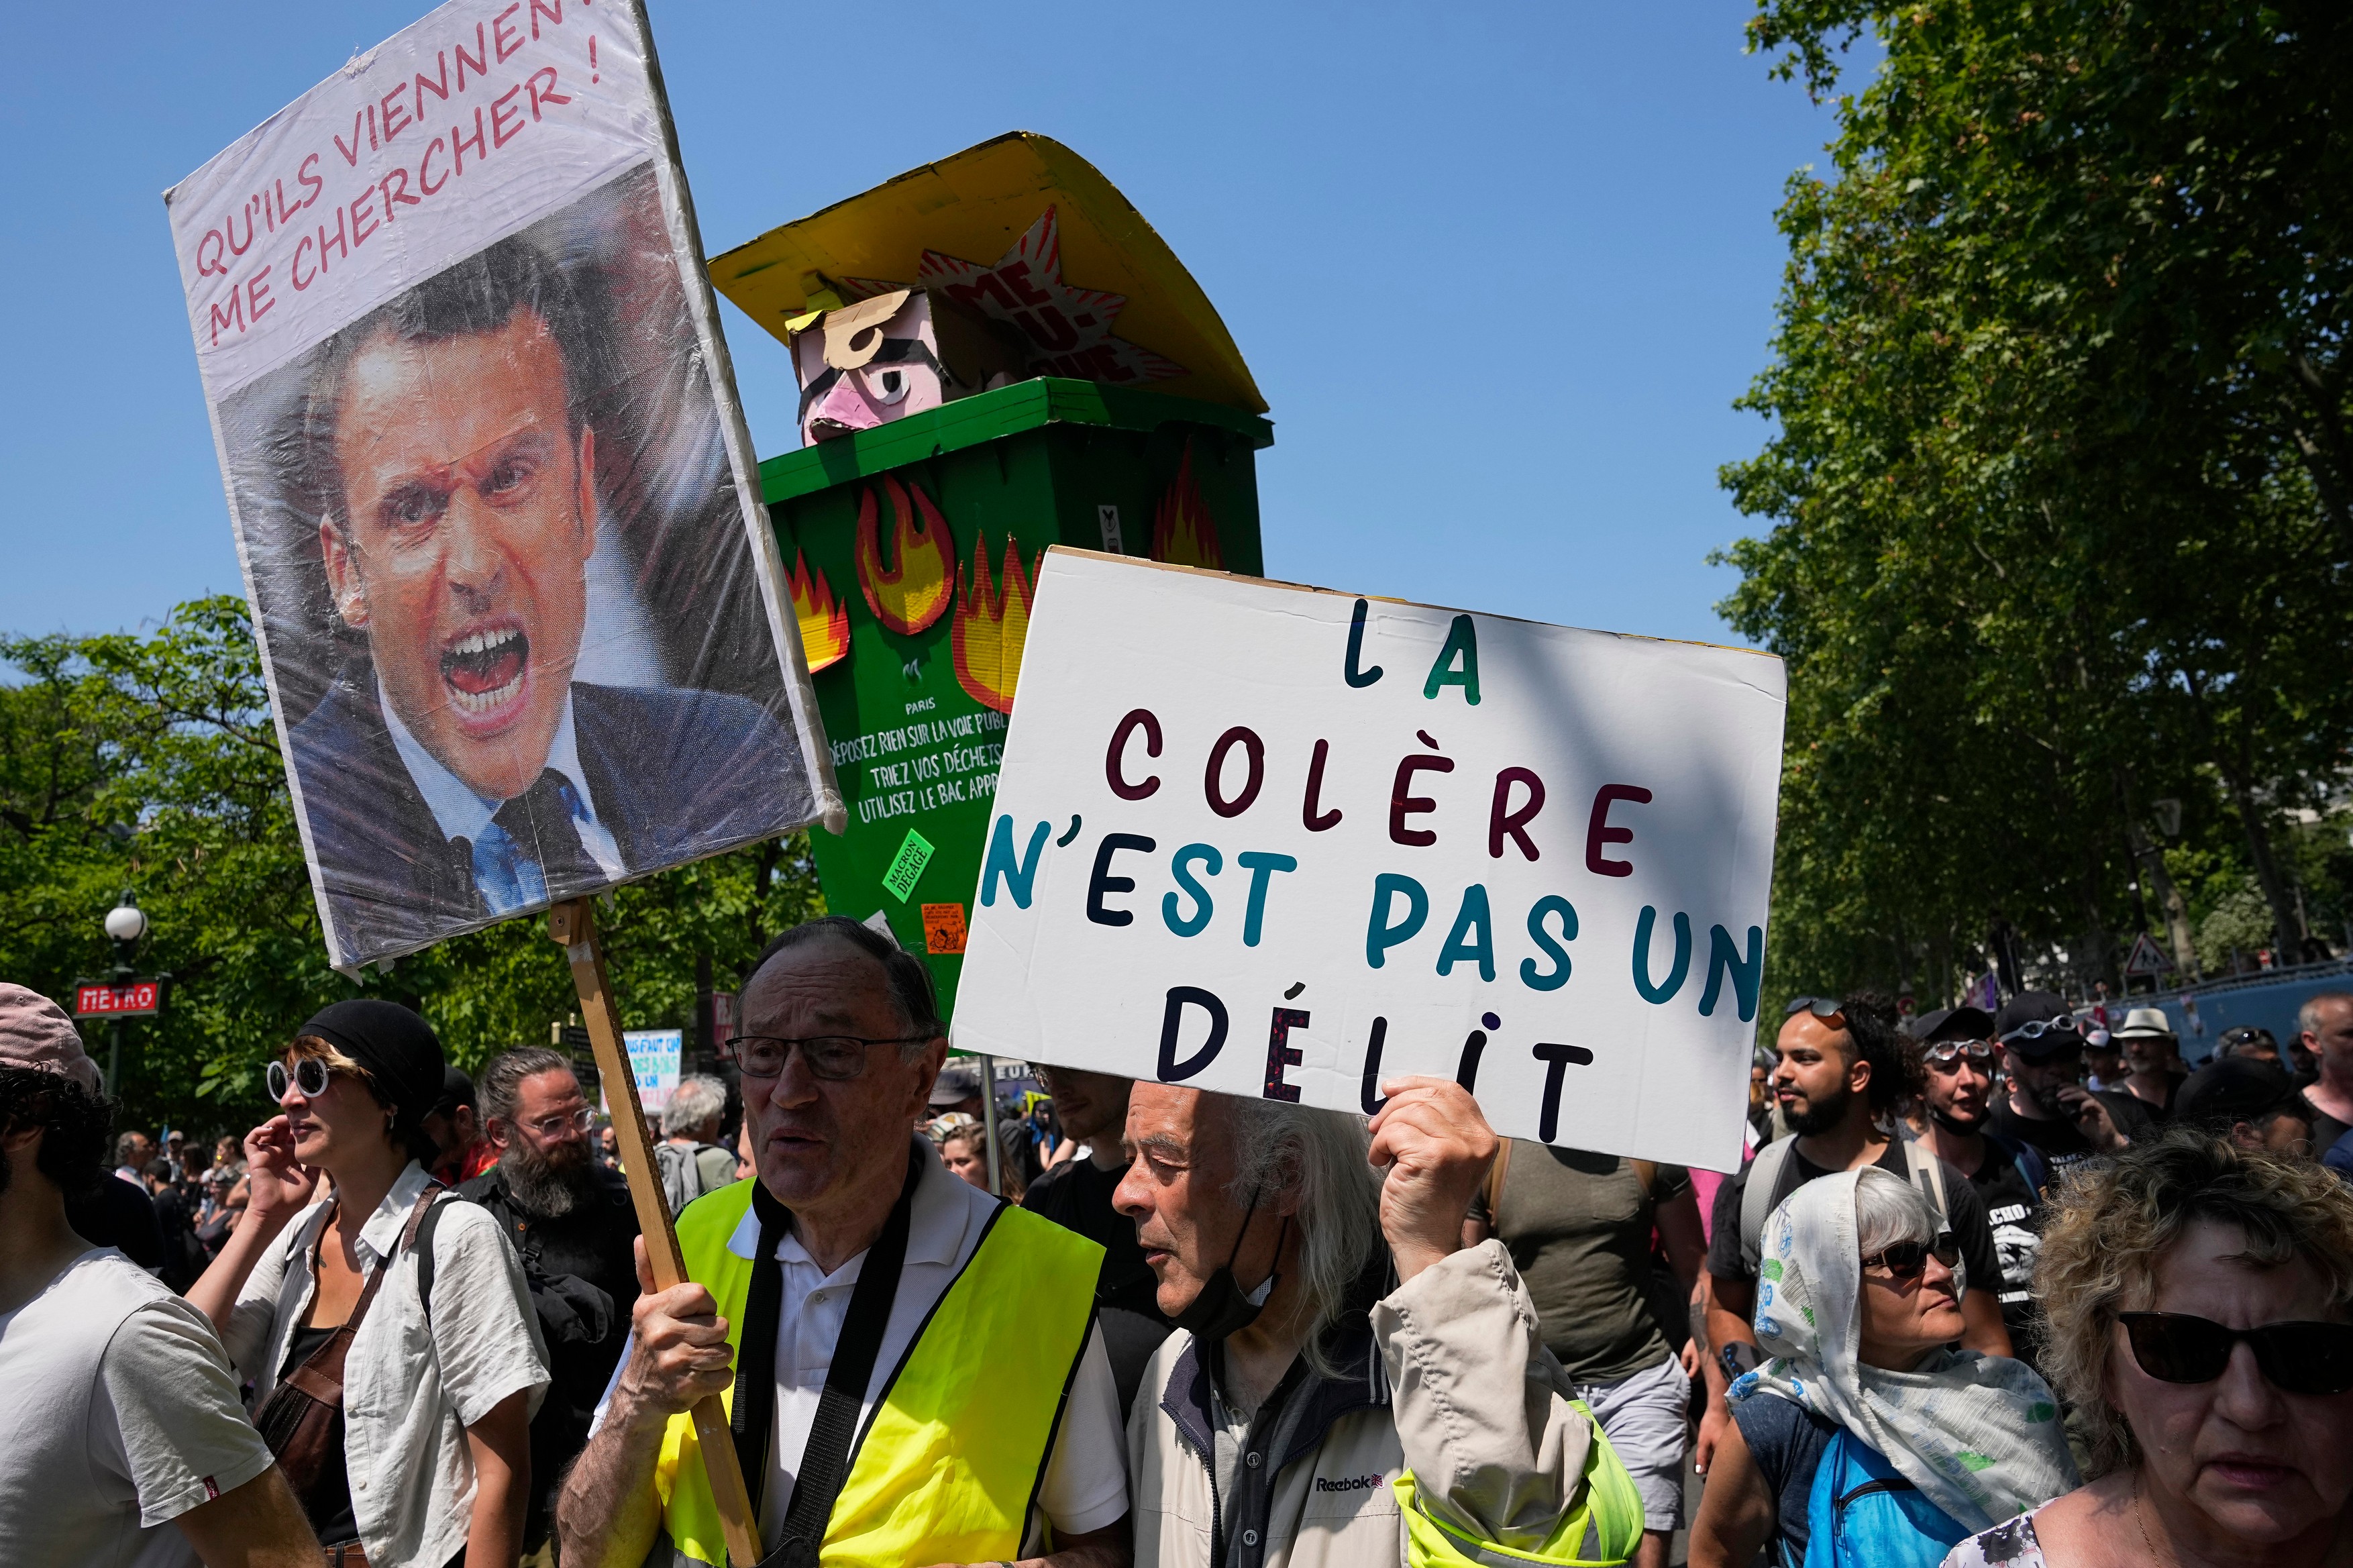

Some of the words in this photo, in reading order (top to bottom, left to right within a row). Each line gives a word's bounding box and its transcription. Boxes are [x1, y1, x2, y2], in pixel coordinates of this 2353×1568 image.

[197, 153, 323, 277] QU'ILS
[334, 0, 592, 167] VIENNEN
[211, 264, 276, 347] ME
[292, 66, 572, 291] CHERCHER
[588, 35, 600, 85] !
[1344, 598, 1481, 706] LA
[906, 696, 935, 715] PARIS
[878, 728, 907, 755] RIEN
[907, 723, 931, 748] SUR
[931, 720, 948, 743] LA
[947, 715, 975, 738] VOIE
[975, 711, 1010, 733] PUBL
[870, 762, 910, 789] TRIEZ
[912, 753, 940, 782] VOS
[943, 743, 1002, 774] DÉCHETS
[858, 790, 916, 824] UTILISEZ
[920, 787, 937, 811] LE
[937, 780, 965, 805] BAC
[1106, 709, 1652, 877] COLÈRE
[889, 839, 917, 886] MACRON
[980, 815, 1298, 947] N'EST
[1366, 873, 1579, 991] PAS
[1632, 905, 1763, 1022] UN
[1316, 1475, 1371, 1492] Reebok
